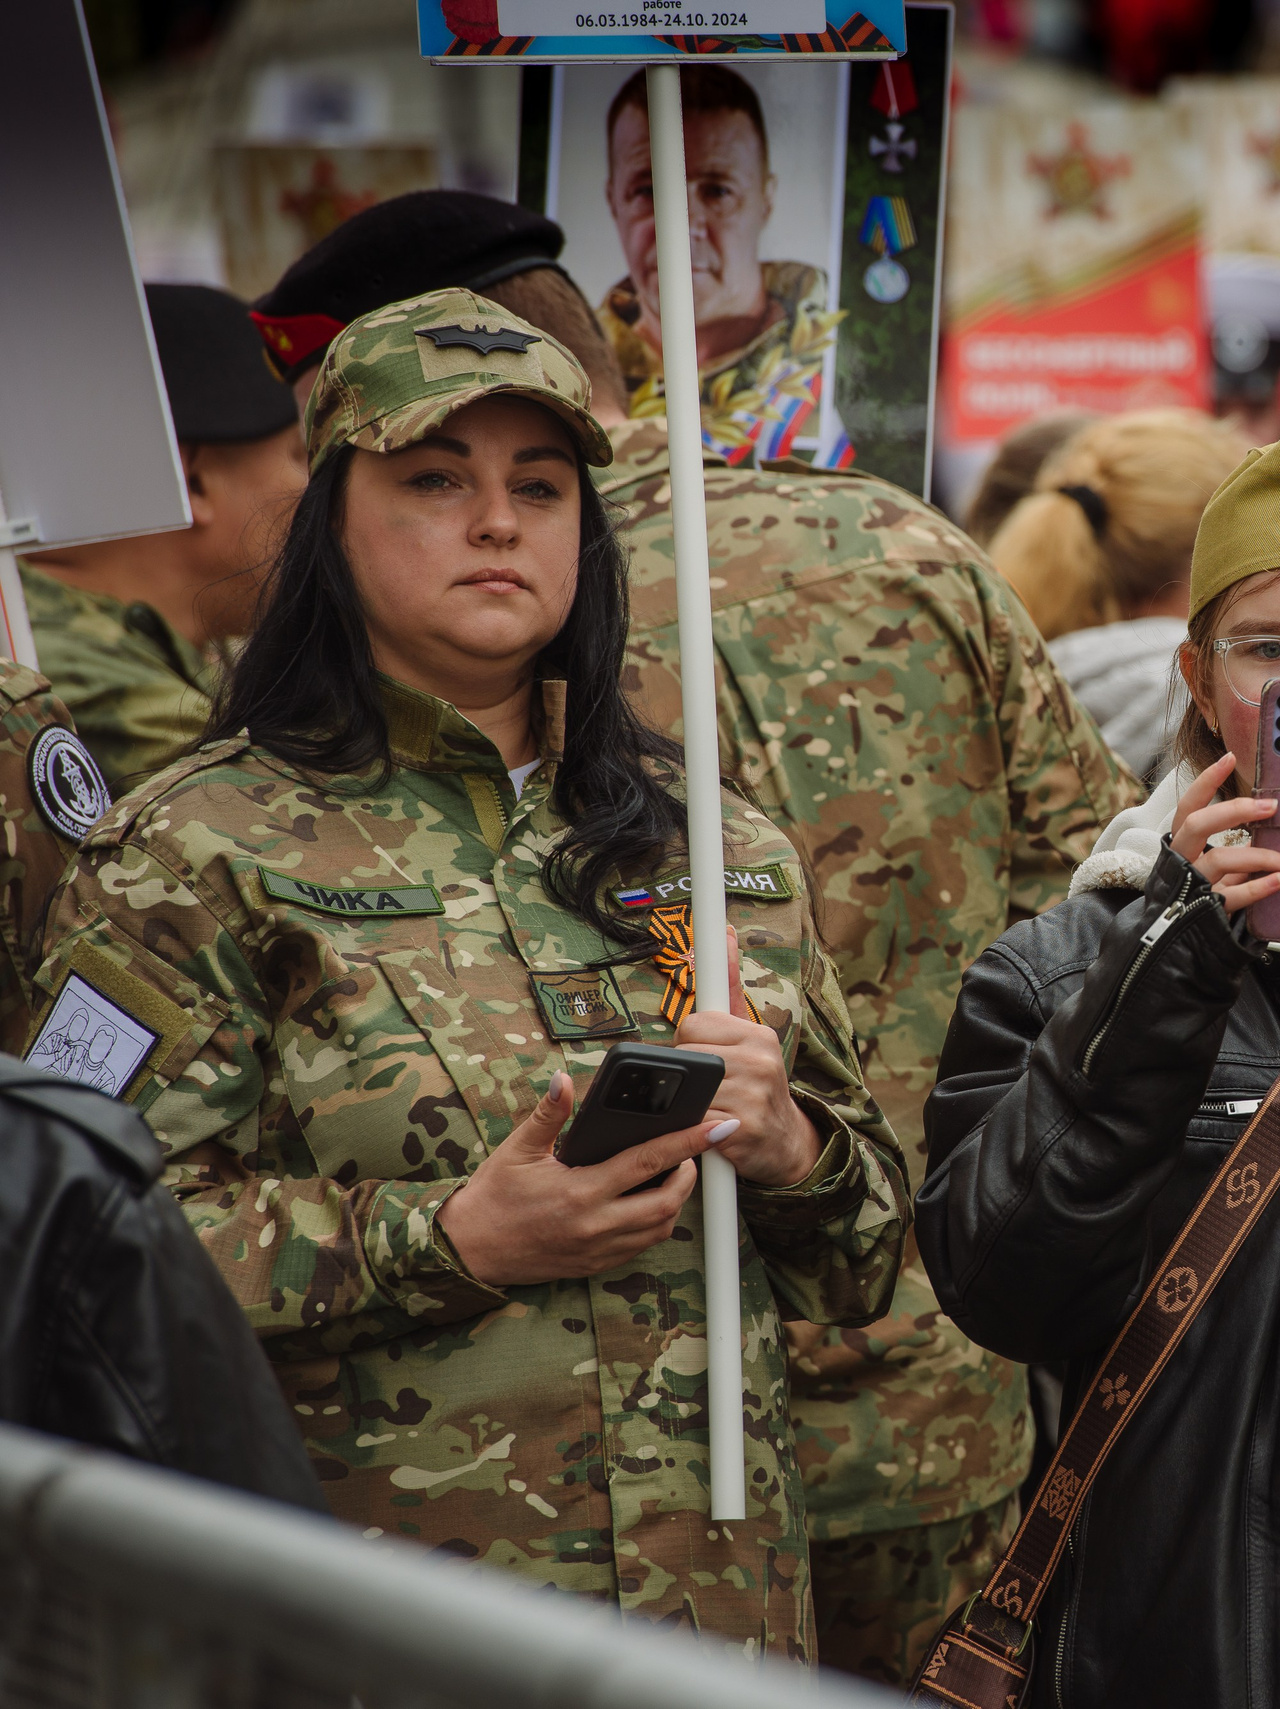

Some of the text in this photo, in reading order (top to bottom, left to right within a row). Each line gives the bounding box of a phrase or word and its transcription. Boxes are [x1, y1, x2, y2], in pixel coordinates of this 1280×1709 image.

[643, 0, 682, 11] работе
[575, 13, 748, 27] 06.03.1984-24.10. 2024
[655, 871, 778, 899] РОСИЯ
[293, 881, 406, 911] ЧИКА
[556, 988, 602, 1004] ОФИЦЕР
[559, 1001, 609, 1017] ПУПСИК
